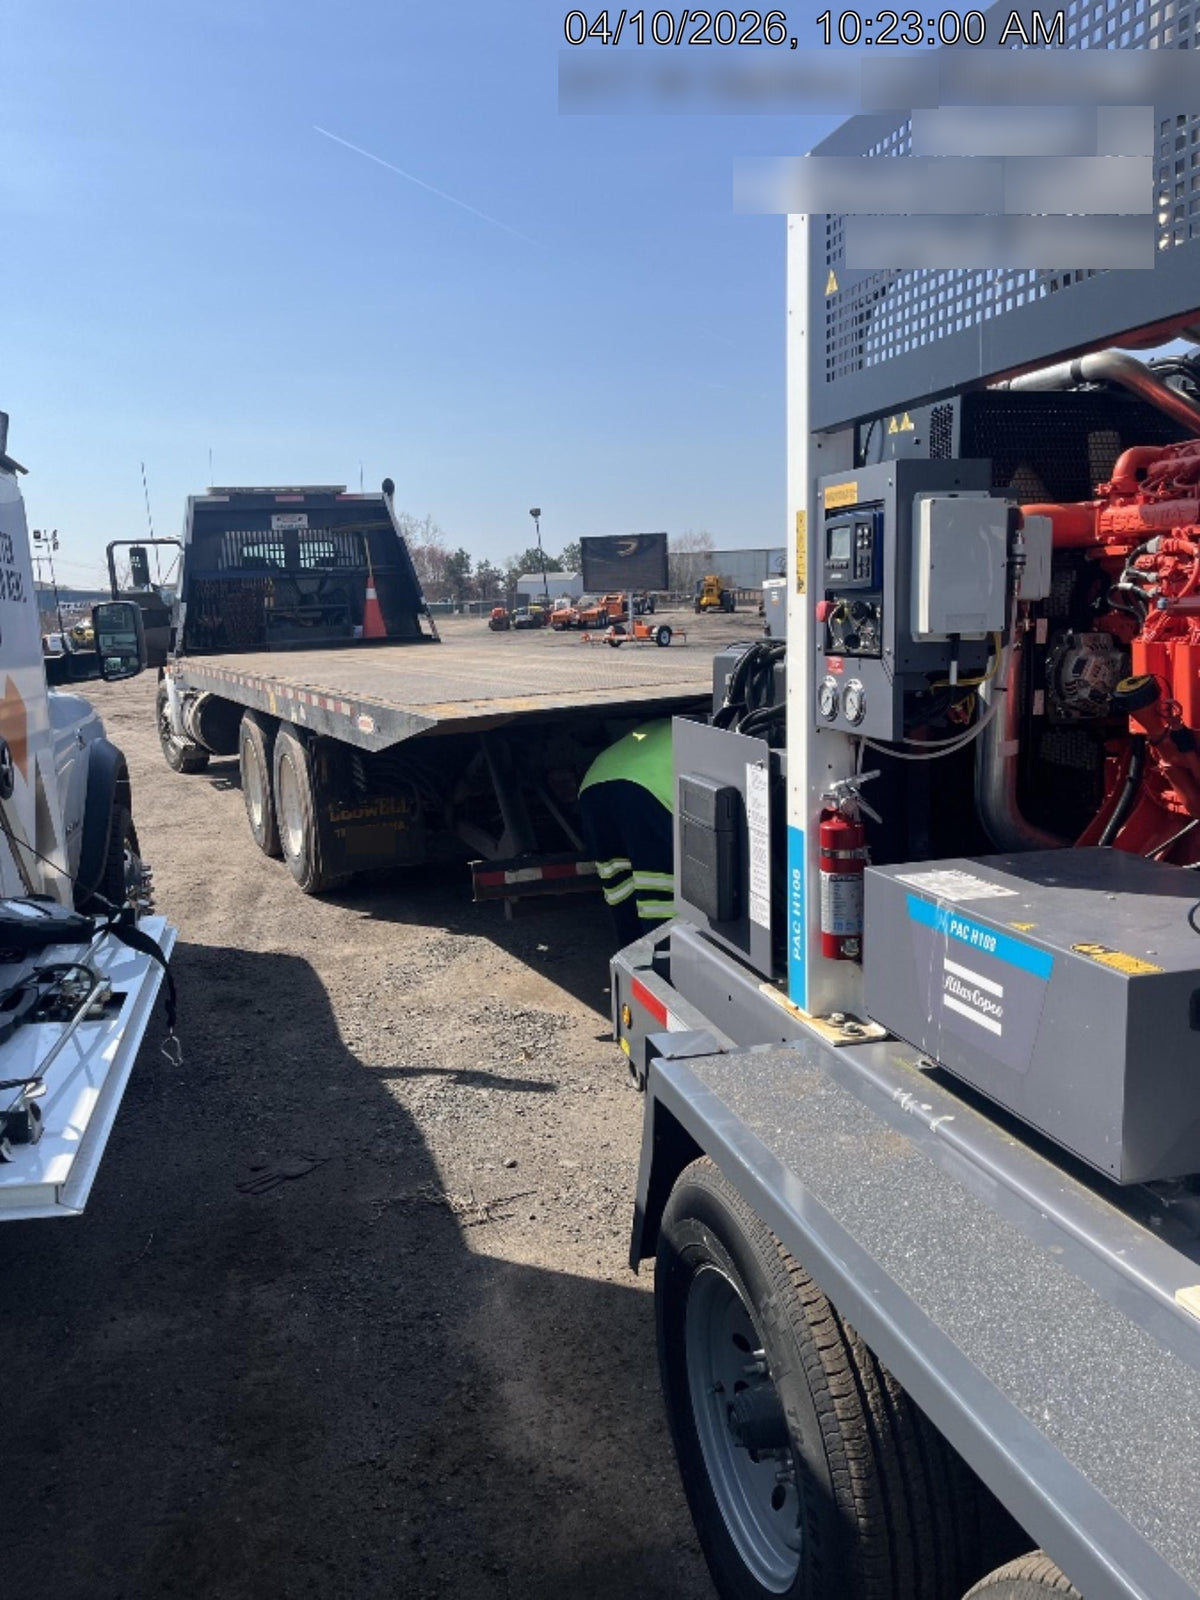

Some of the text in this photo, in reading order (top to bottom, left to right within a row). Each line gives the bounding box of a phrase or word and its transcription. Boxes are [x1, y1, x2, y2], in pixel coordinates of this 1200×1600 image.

[792, 920, 801, 961] PAC
[950, 919, 970, 941] PAC
[943, 975, 1003, 1018] Atlas Copco
